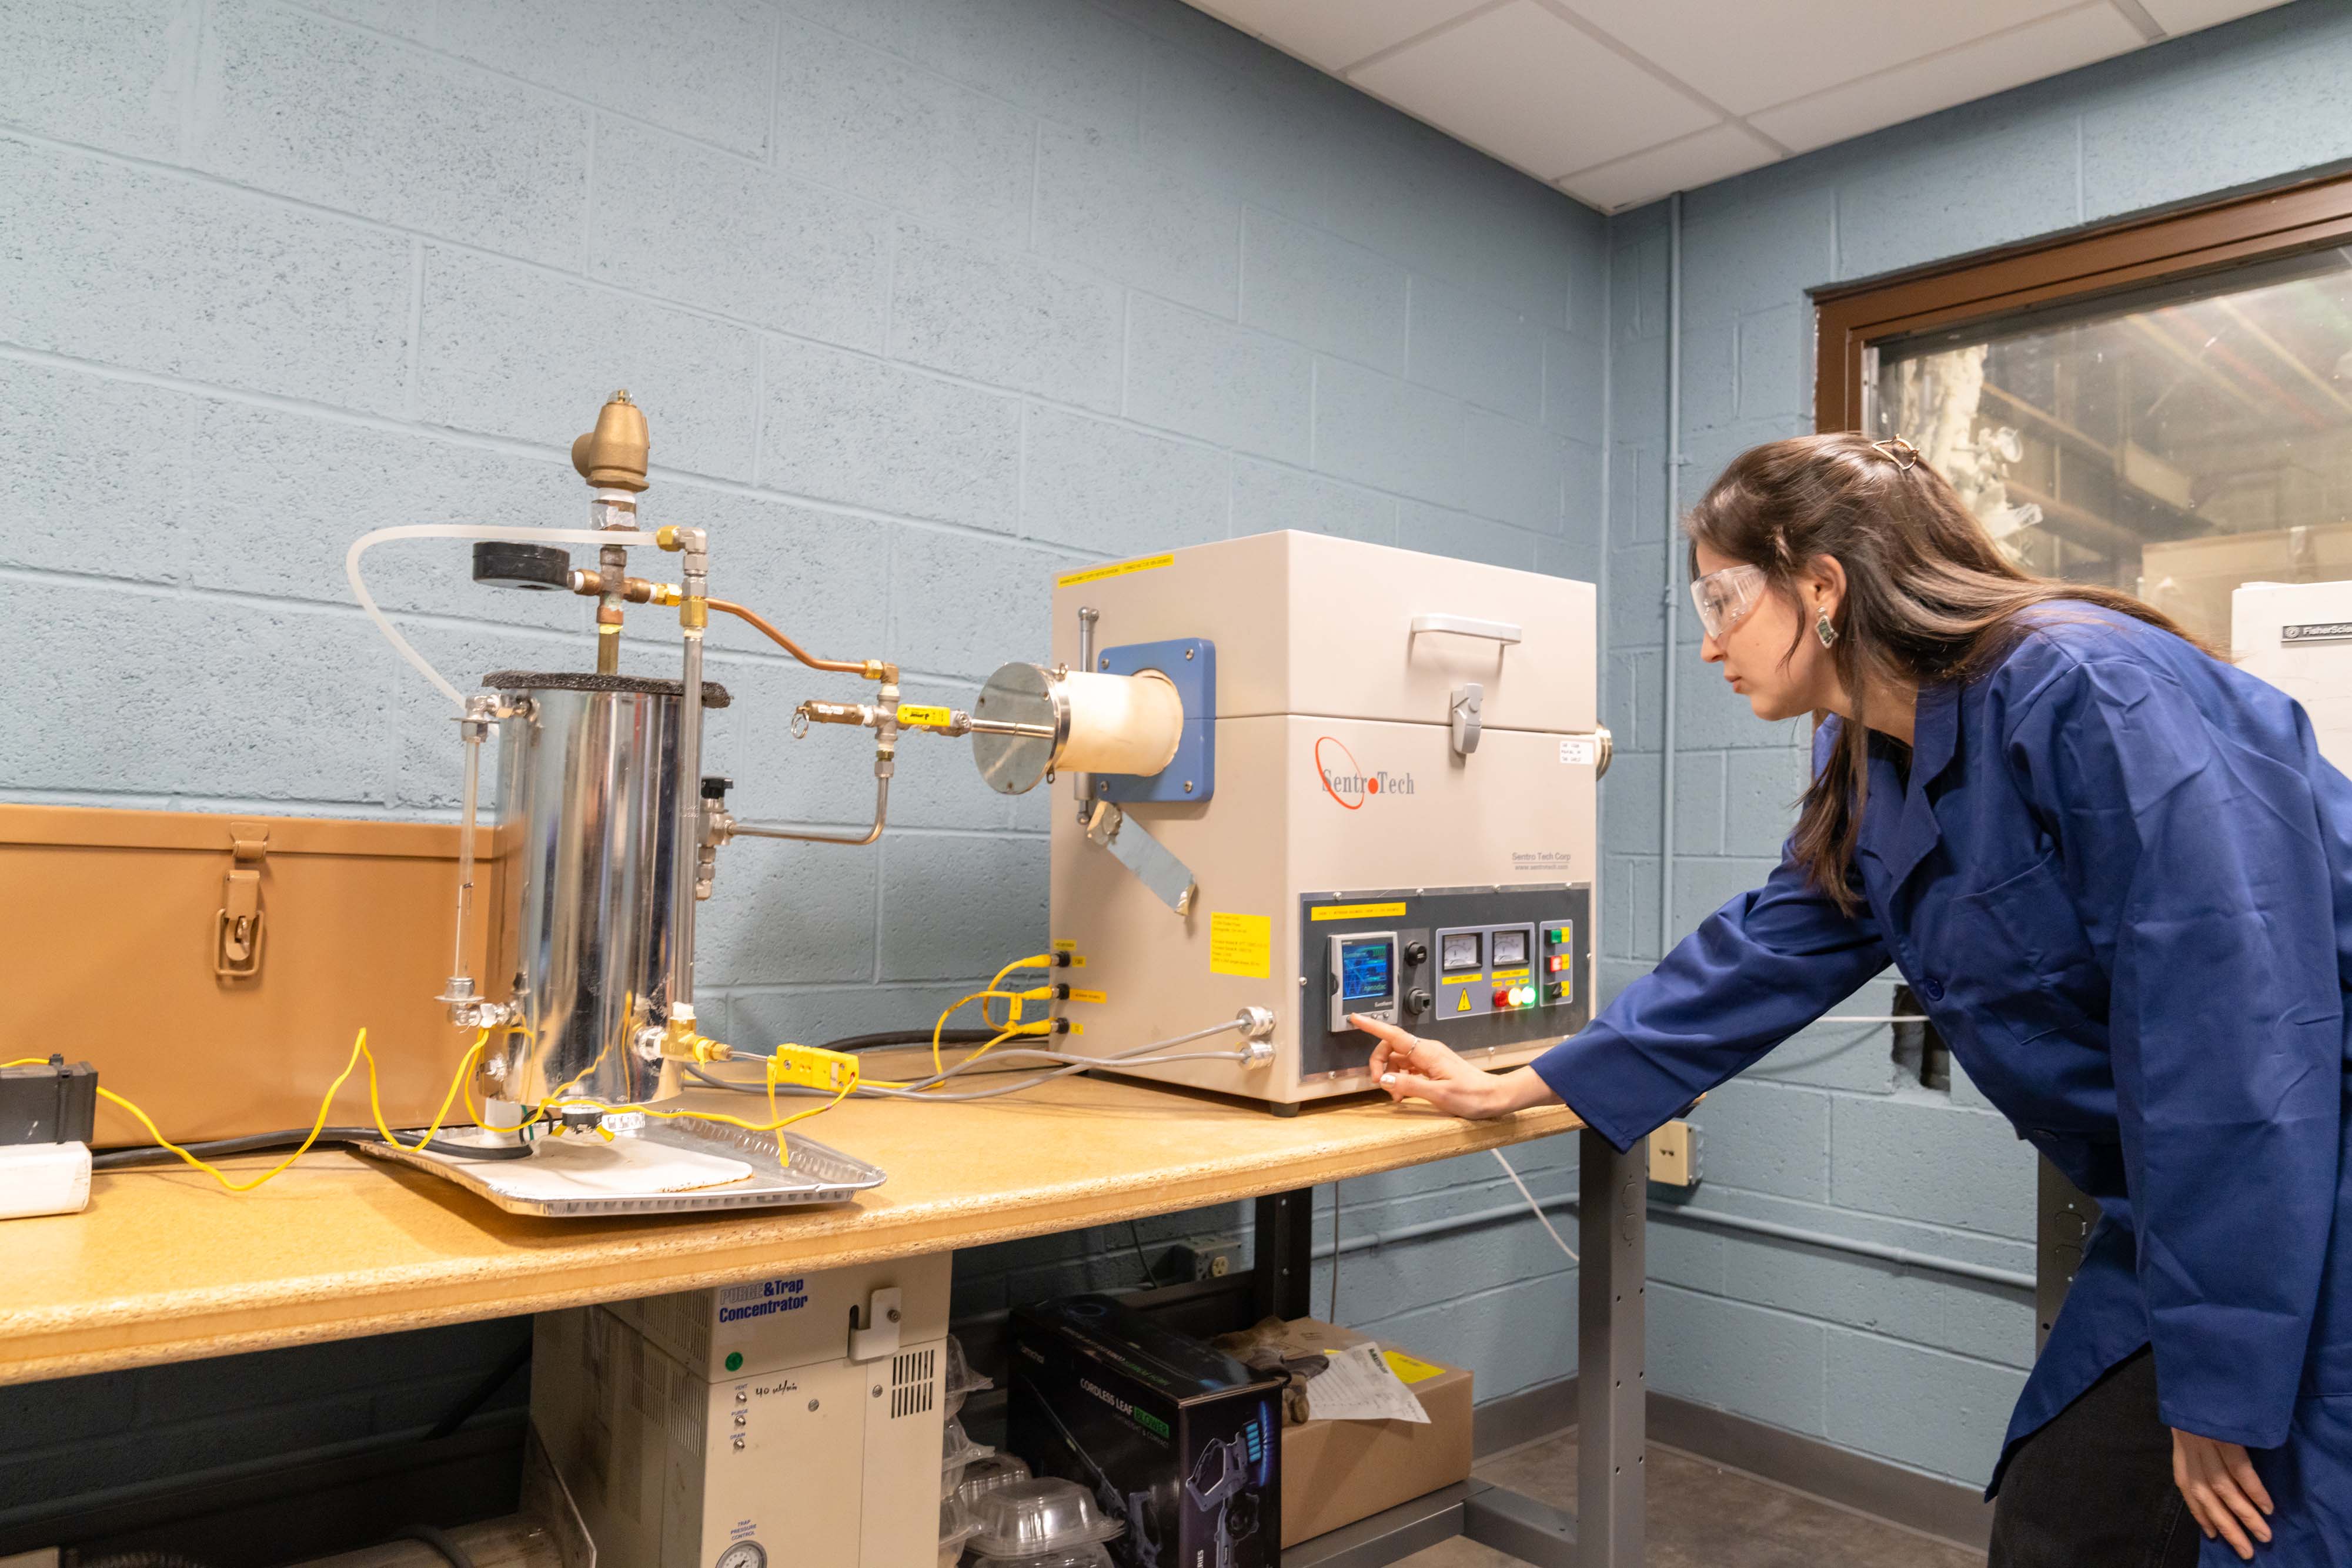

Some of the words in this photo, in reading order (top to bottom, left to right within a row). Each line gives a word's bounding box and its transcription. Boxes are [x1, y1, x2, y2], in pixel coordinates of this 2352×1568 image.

[1512, 851, 1536, 861] Sentro
[1537, 851, 1553, 861] Tech
[1555, 852, 1571, 861] Corp
[719, 1295, 808, 1323] Concentrator
[756, 1387, 770, 1398] 40
[1080, 1378, 1115, 1406] CORDLESS
[1116, 1398, 1134, 1416] LEAF
[730, 1432, 746, 1440] DRAIN
